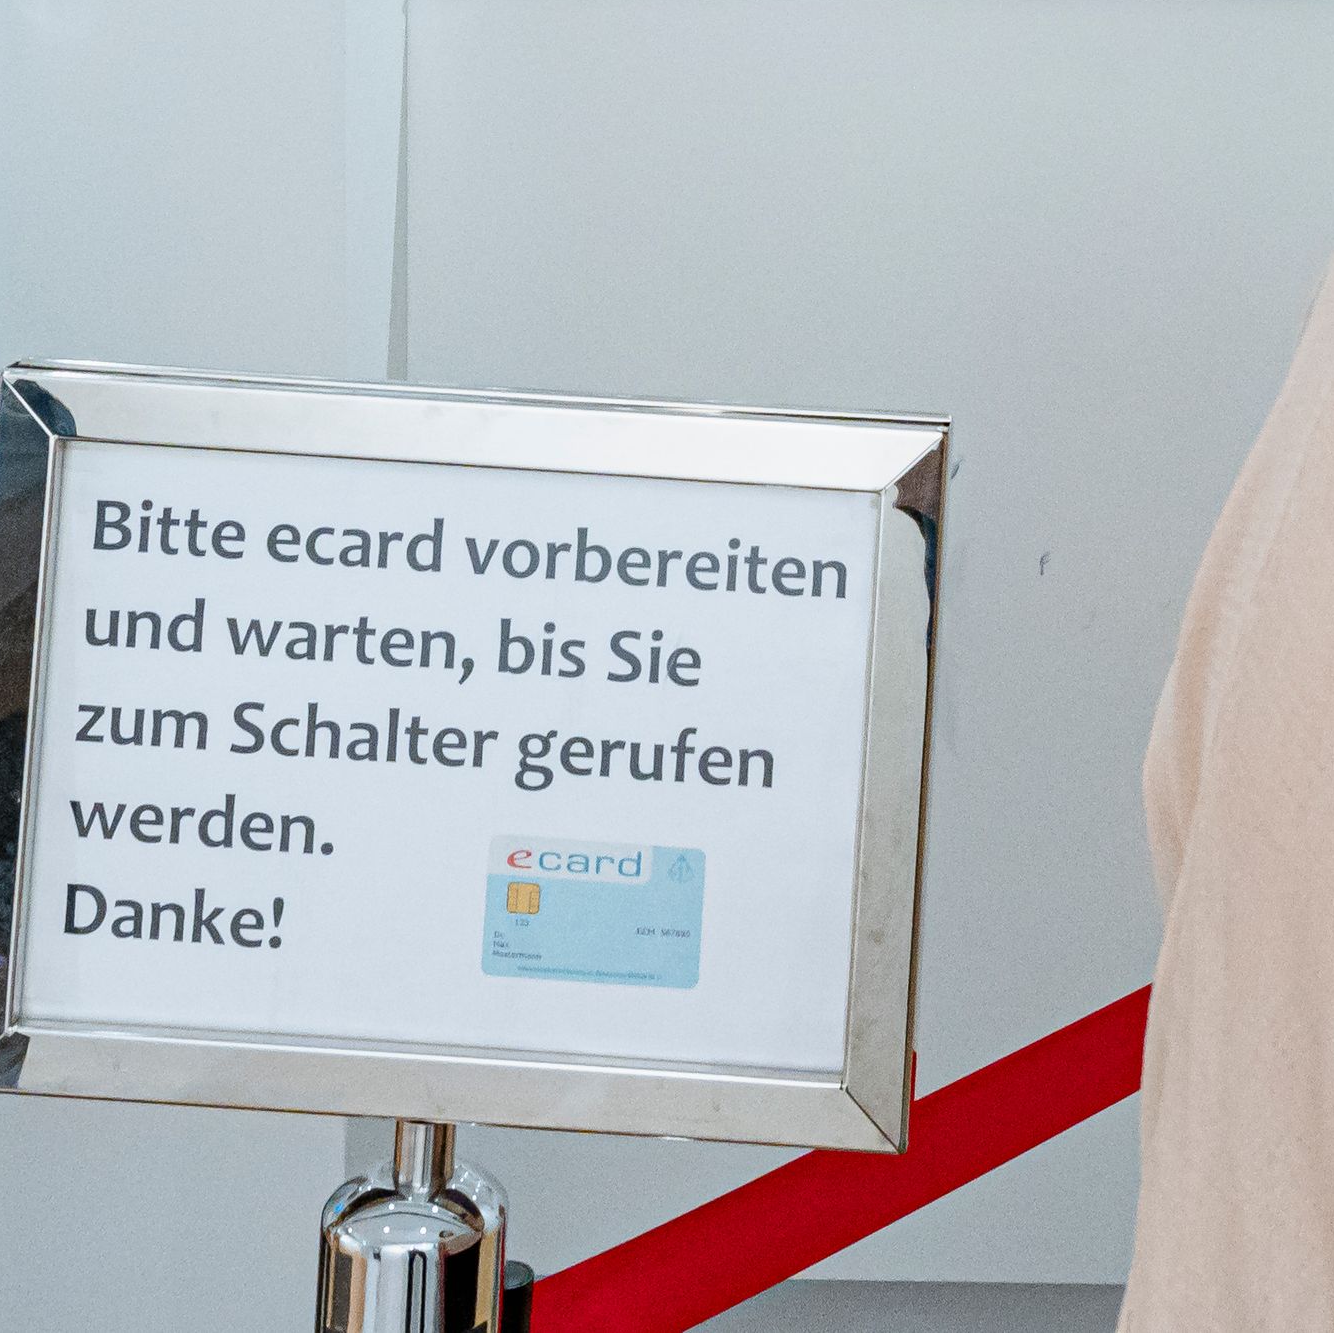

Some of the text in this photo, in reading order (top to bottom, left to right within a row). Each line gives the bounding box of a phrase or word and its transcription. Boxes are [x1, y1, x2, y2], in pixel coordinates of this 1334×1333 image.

[92, 499, 848, 600] Bitte ecard vorbereiten
[85, 597, 703, 687] und warten, bis Sie
[75, 701, 775, 792] zum Schalter gerufen
[69, 793, 335, 856] werden.
[506, 849, 643, 877] ecard
[63, 883, 285, 949] Danke!
